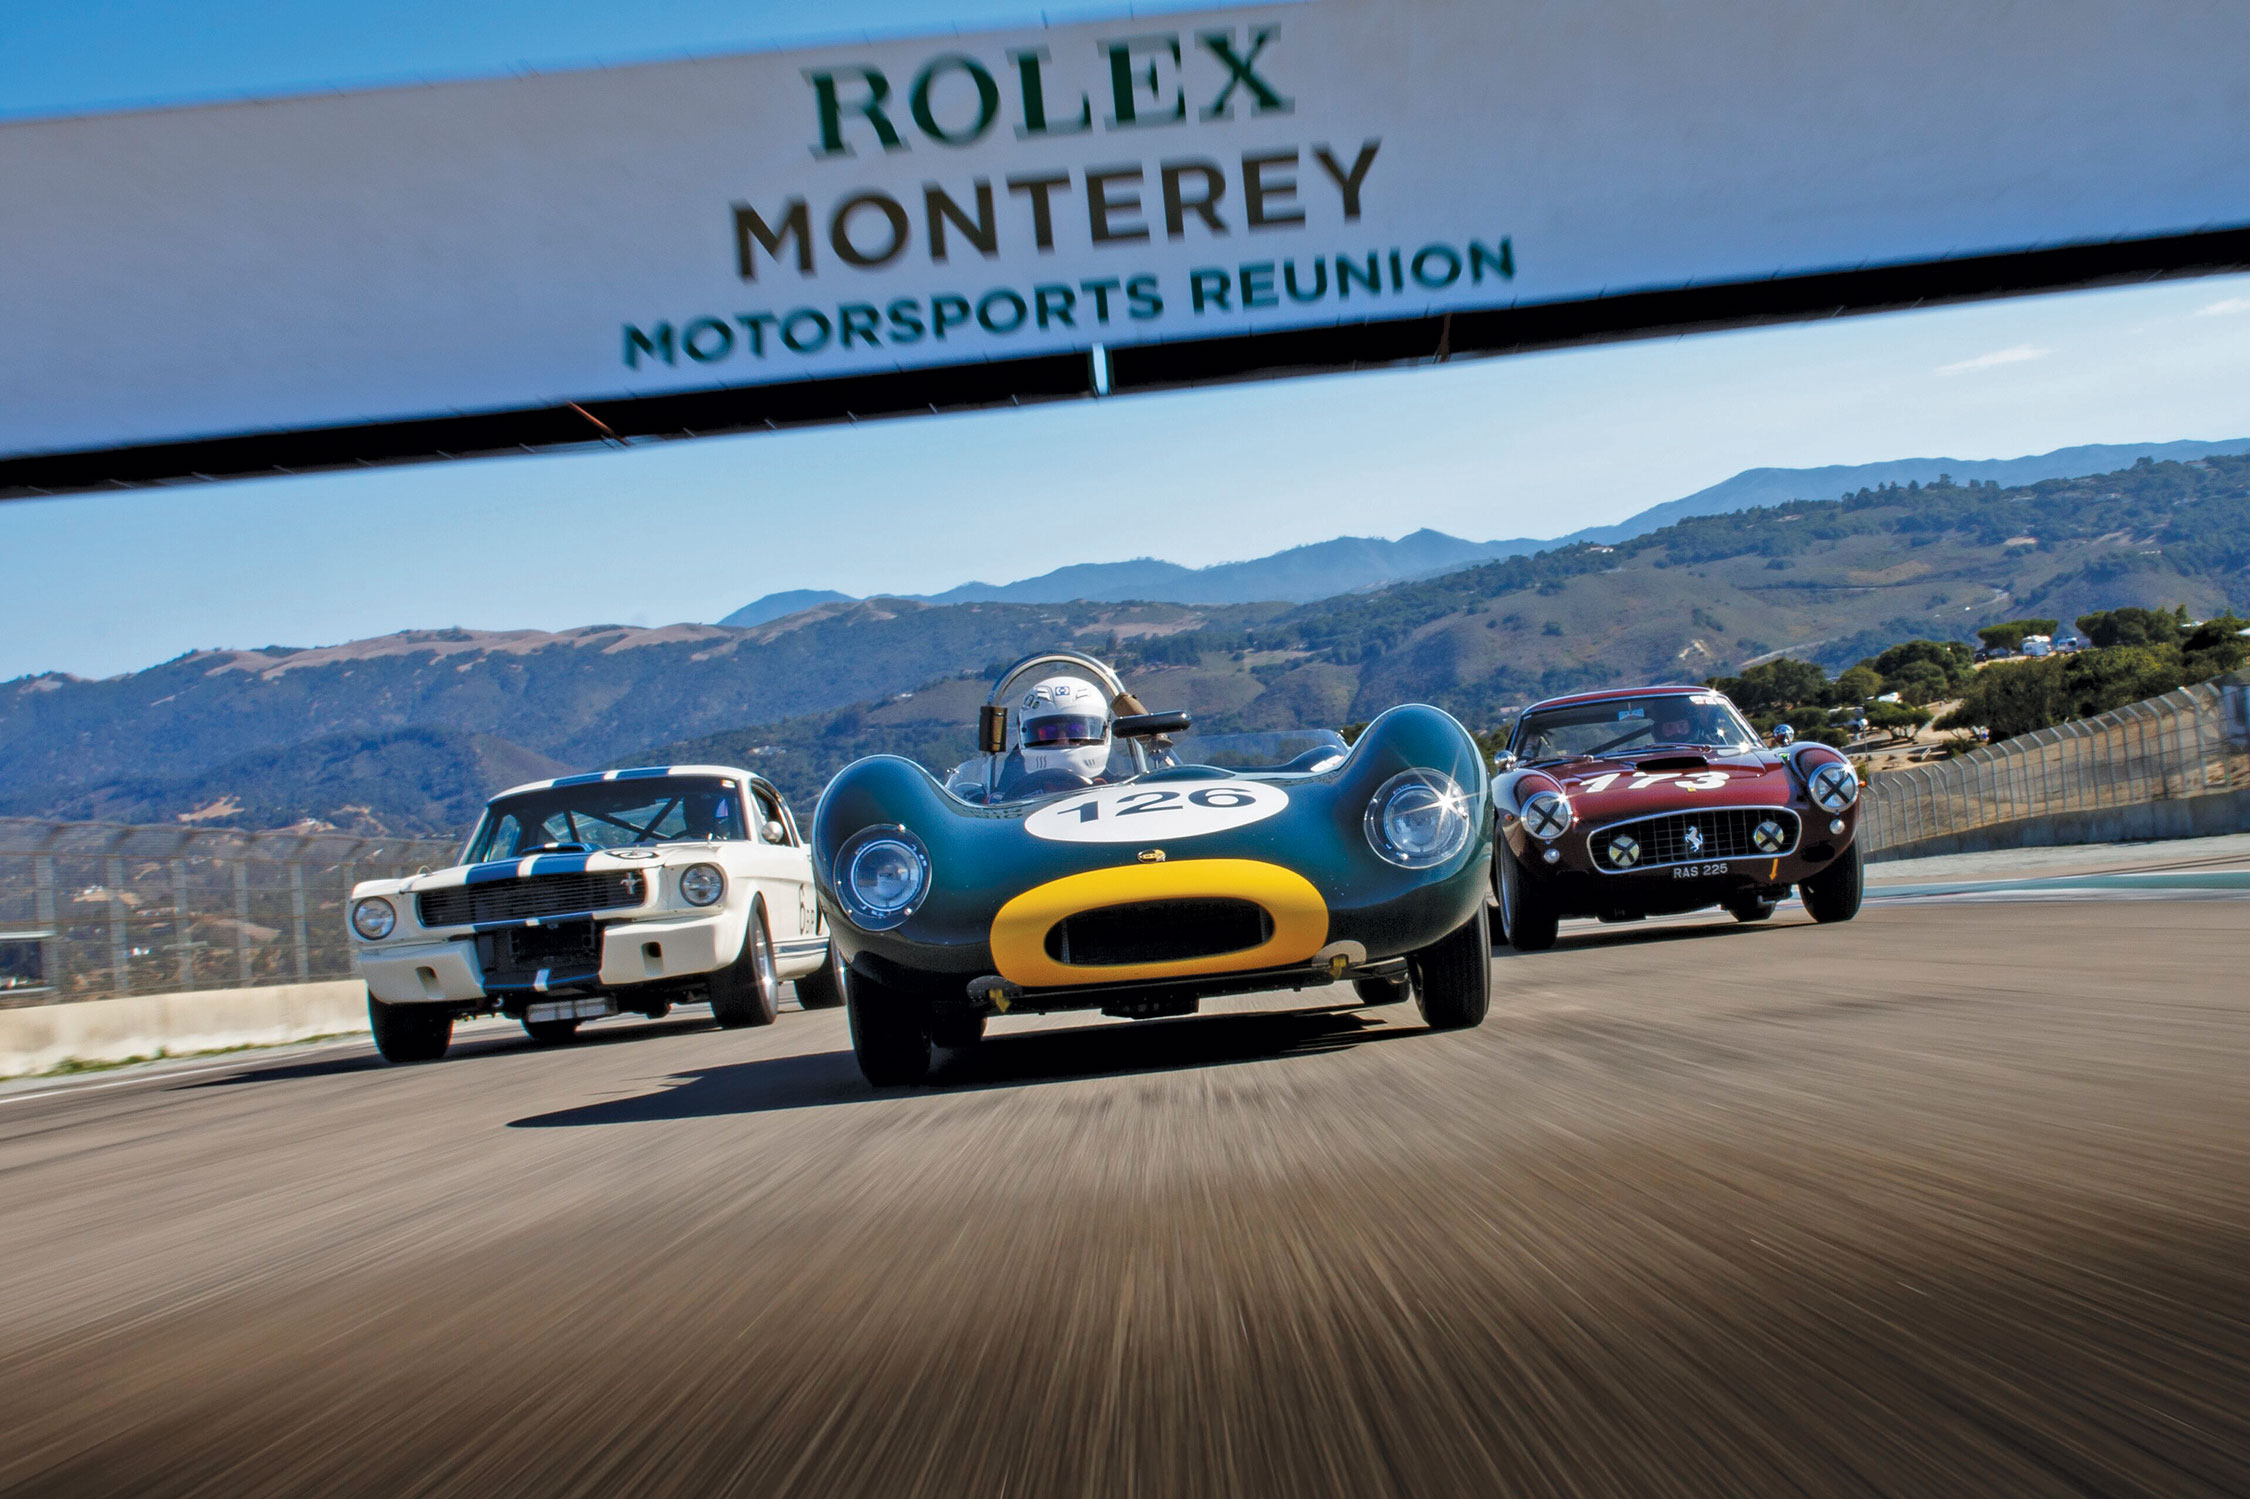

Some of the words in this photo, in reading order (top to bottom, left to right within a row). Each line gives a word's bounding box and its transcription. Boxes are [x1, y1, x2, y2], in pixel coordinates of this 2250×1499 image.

[803, 23, 1296, 160] ROLEX
[731, 138, 1382, 282] MONTEREY
[621, 273, 1164, 371] MOTORSPORTS
[1190, 236, 1516, 315] REUNION
[1057, 787, 1257, 823] 126
[1579, 771, 1730, 793] 173
[1673, 866, 1699, 879] RAS
[1703, 863, 1728, 876] 225
